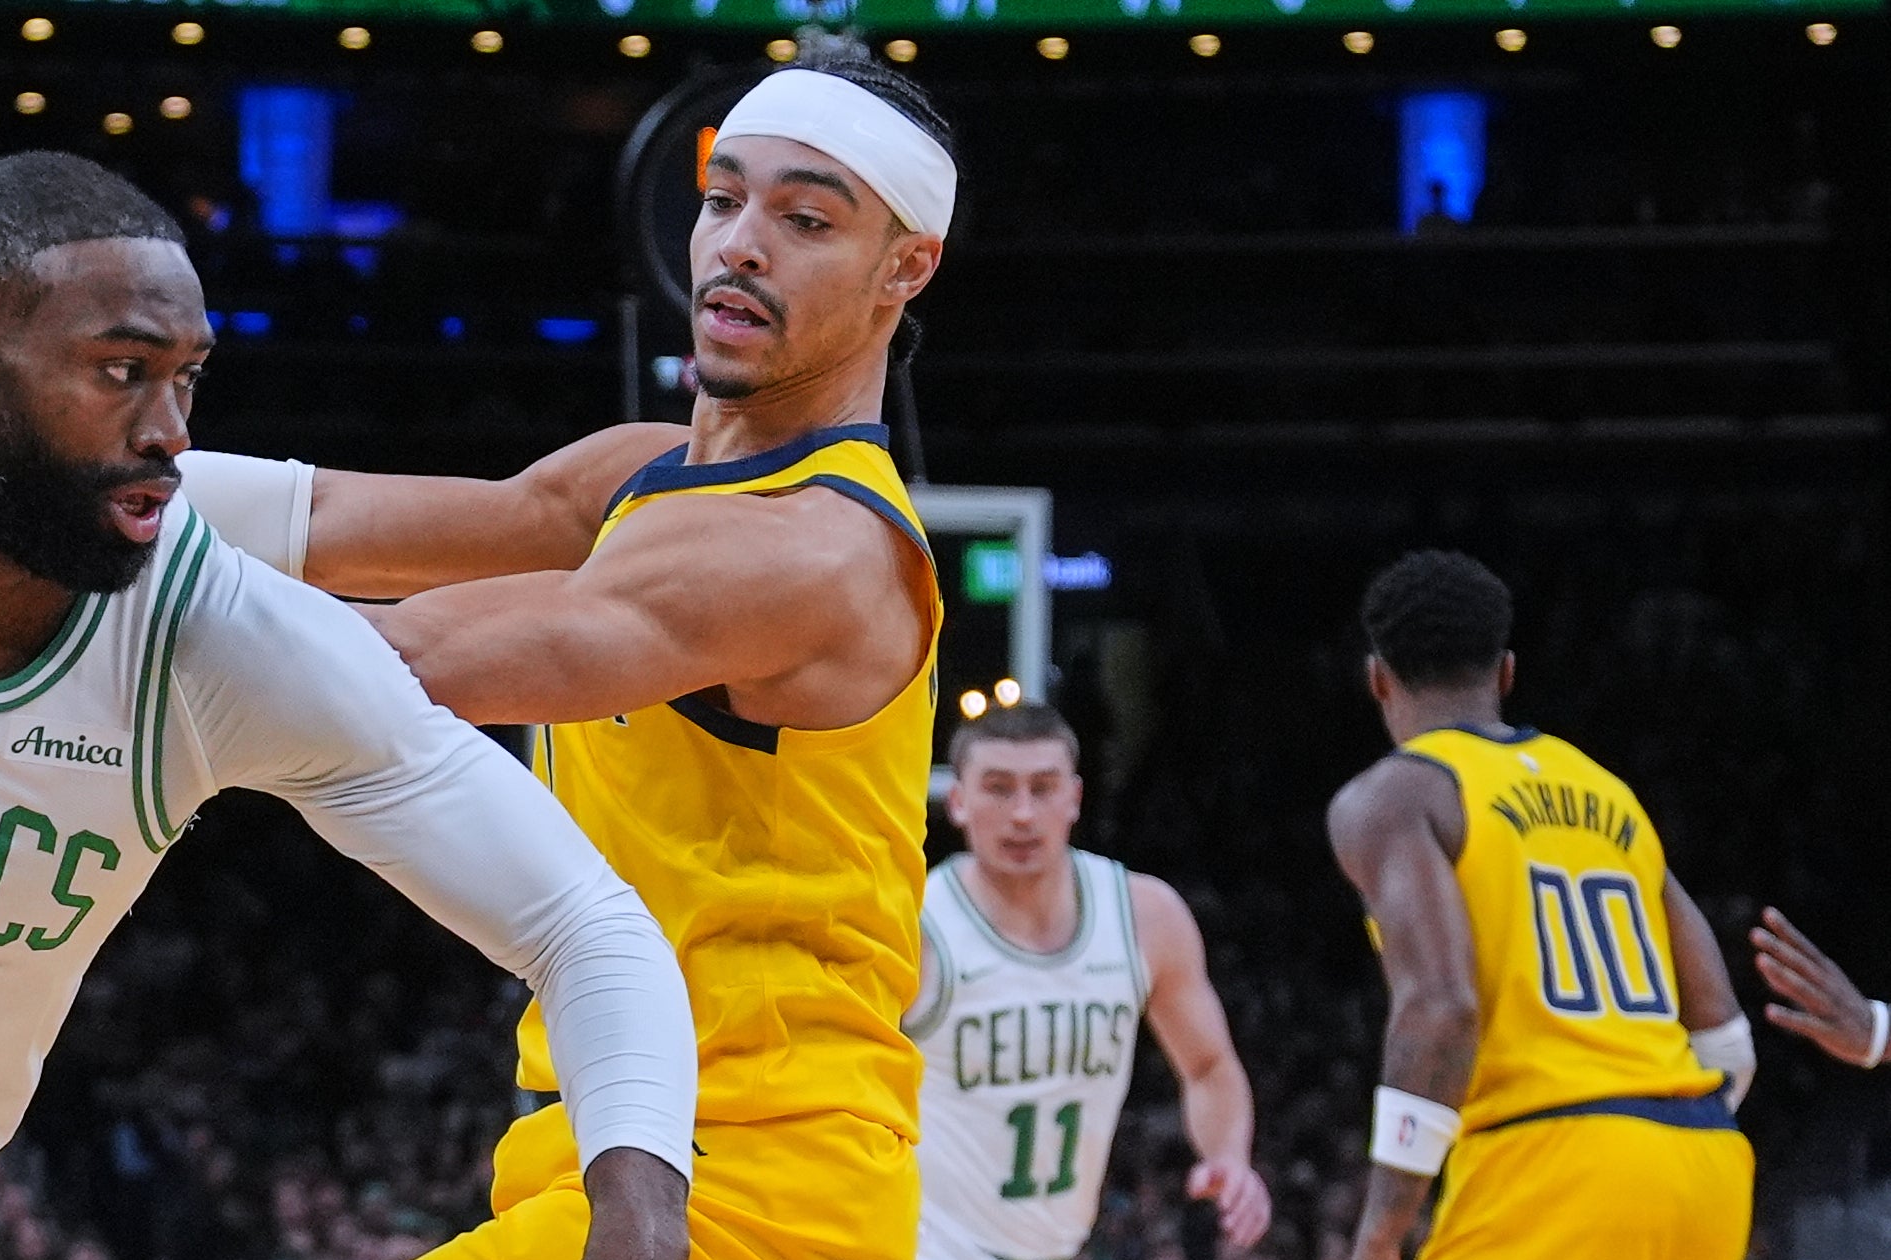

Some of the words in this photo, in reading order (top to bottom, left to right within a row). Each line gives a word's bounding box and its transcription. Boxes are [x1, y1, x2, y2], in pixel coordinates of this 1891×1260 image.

[11, 726, 123, 767] Amica
[1491, 782, 1638, 854] MATHURIN
[1529, 864, 1678, 1018] 00
[954, 1001, 1132, 1091] CELTICS
[999, 1100, 1084, 1199] 11
